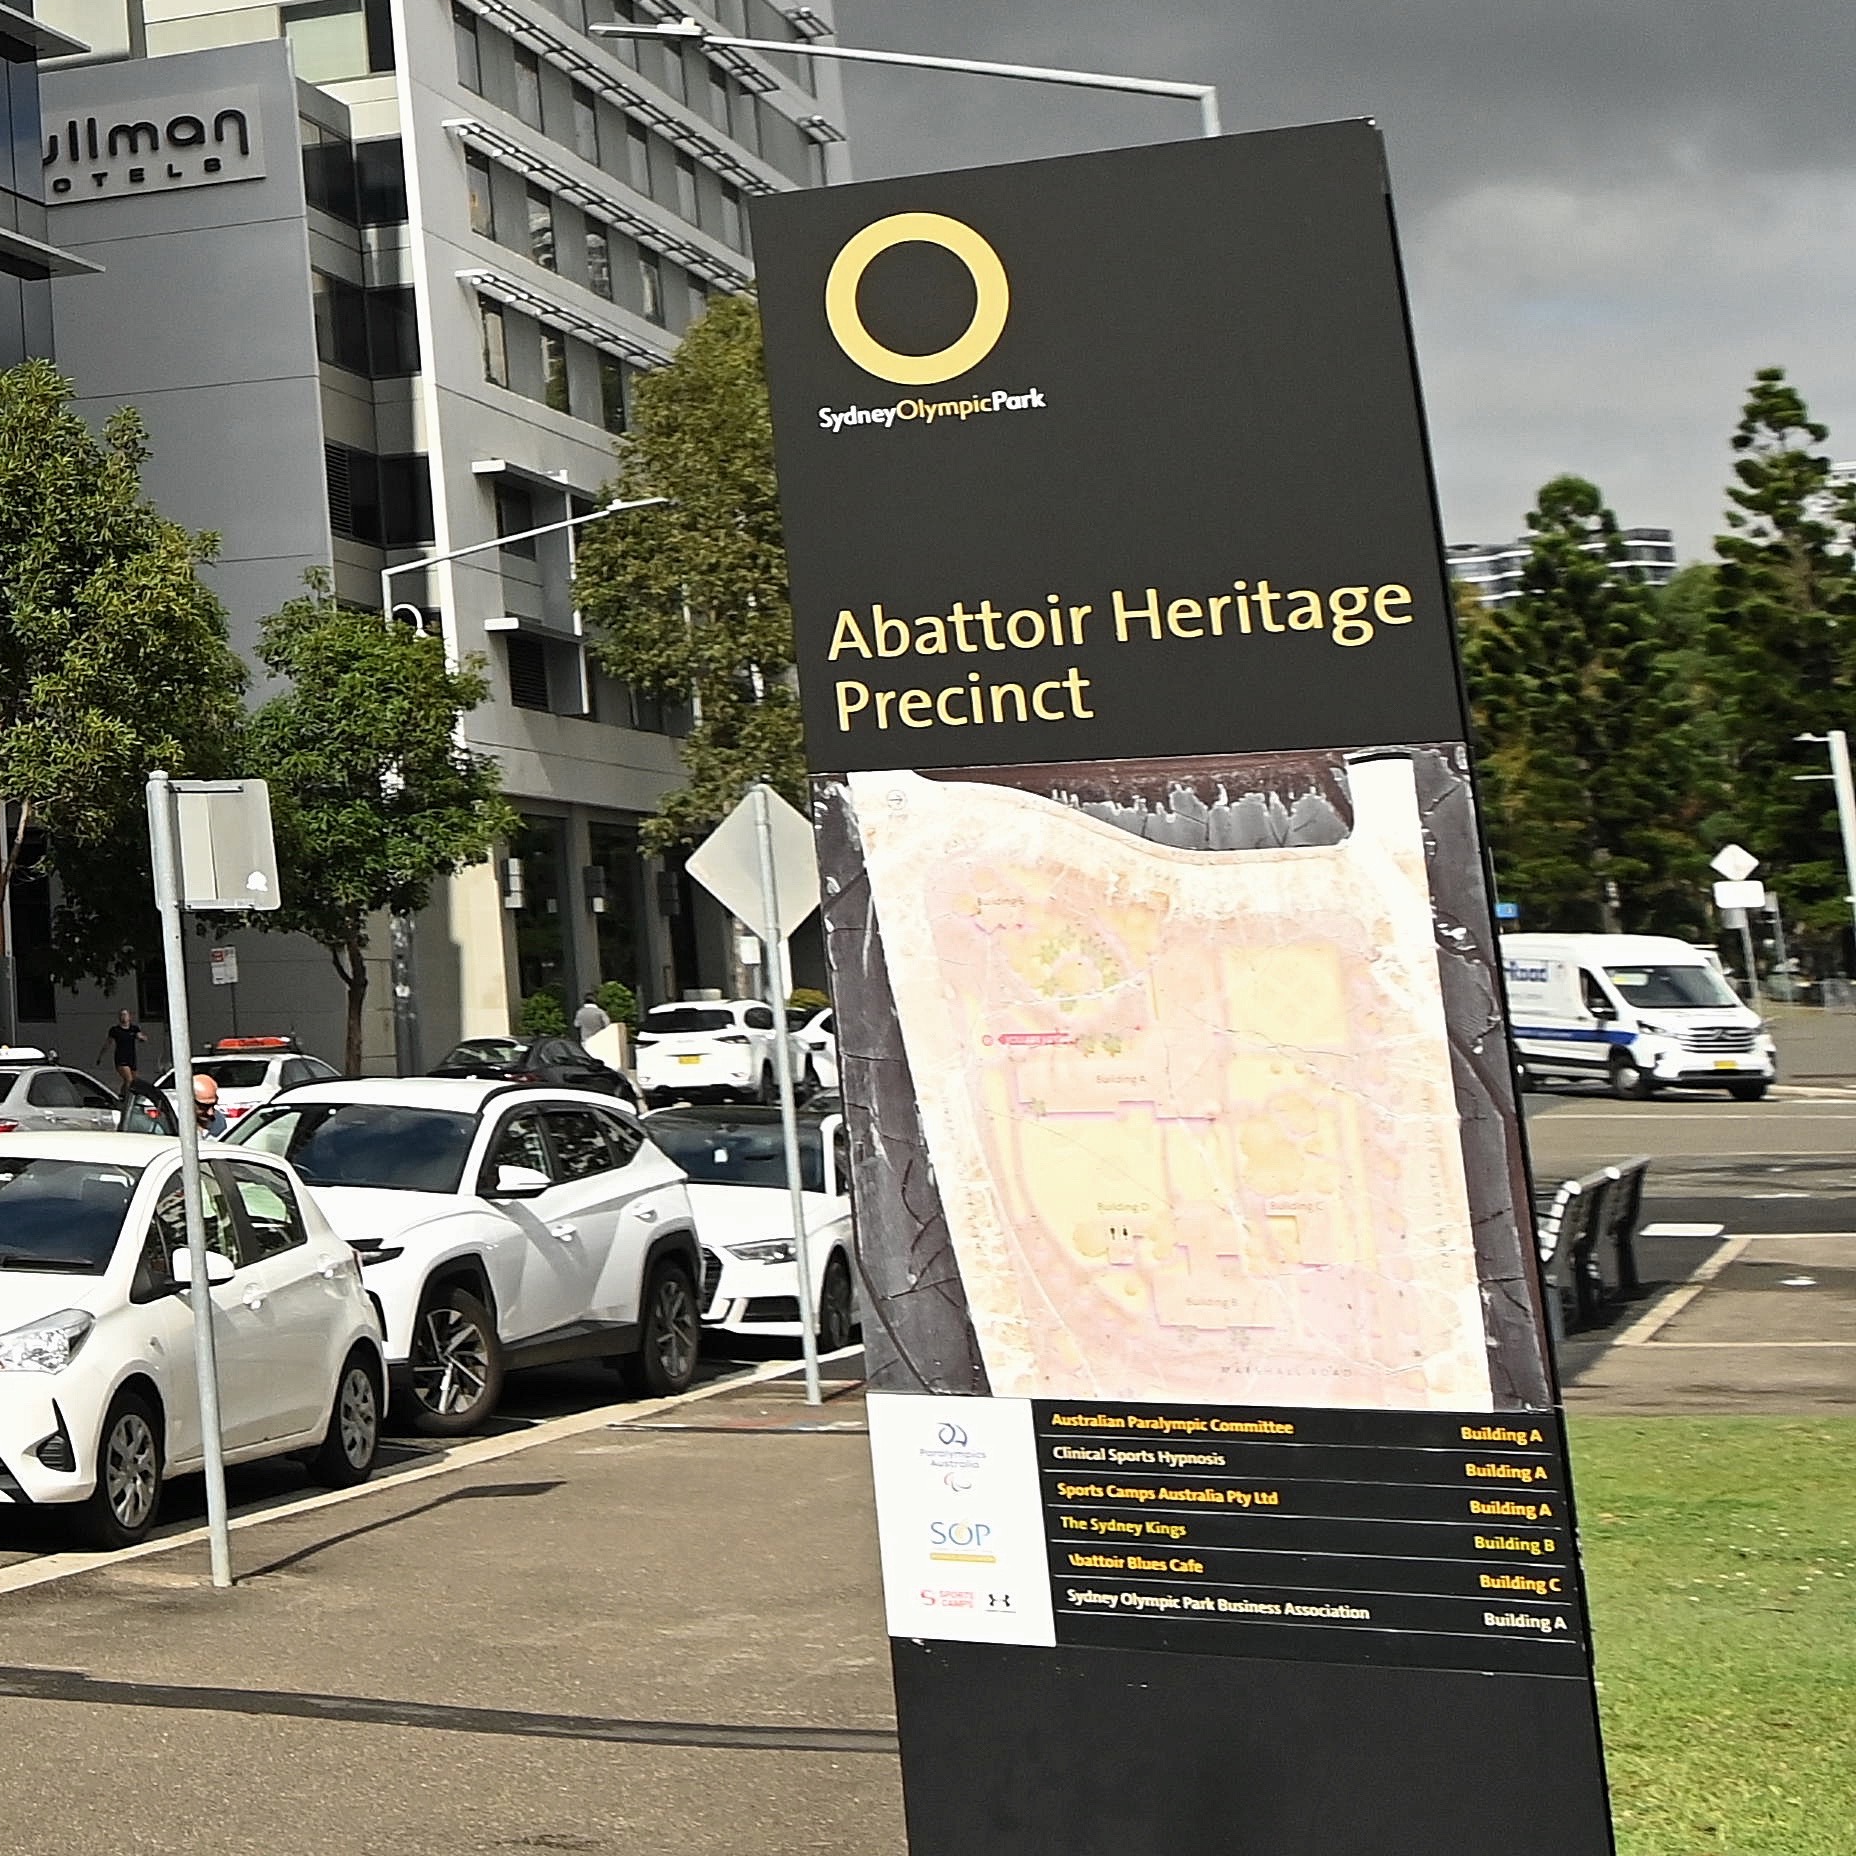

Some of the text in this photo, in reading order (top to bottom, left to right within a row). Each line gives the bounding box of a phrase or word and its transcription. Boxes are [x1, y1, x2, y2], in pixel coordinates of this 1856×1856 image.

[818, 388, 1047, 432] SydneyOlympicPark
[828, 580, 1414, 661] Abattoir Heritage
[835, 668, 1094, 733] Precinct
[1052, 1414, 1295, 1435] Australian Paralympic Committee
[1461, 1426, 1543, 1446] Building A
[1052, 1446, 1226, 1467] Clinical Sports Hypnosis
[1465, 1463, 1548, 1483] Building A
[1057, 1482, 1279, 1507] Sports Camps Australia Pty Ltd
[1470, 1500, 1552, 1520] Building A
[930, 1521, 991, 1546] SOP
[1060, 1516, 1186, 1538] The Sydney Kings
[1474, 1535, 1556, 1555] Building B
[1127, 1555, 1167, 1571] Blues
[1170, 1558, 1204, 1573] Cafe
[1479, 1574, 1562, 1594] Building C
[1067, 1588, 1370, 1619] Sydney Olympic Park Business Association
[1484, 1612, 1567, 1633] Building A
